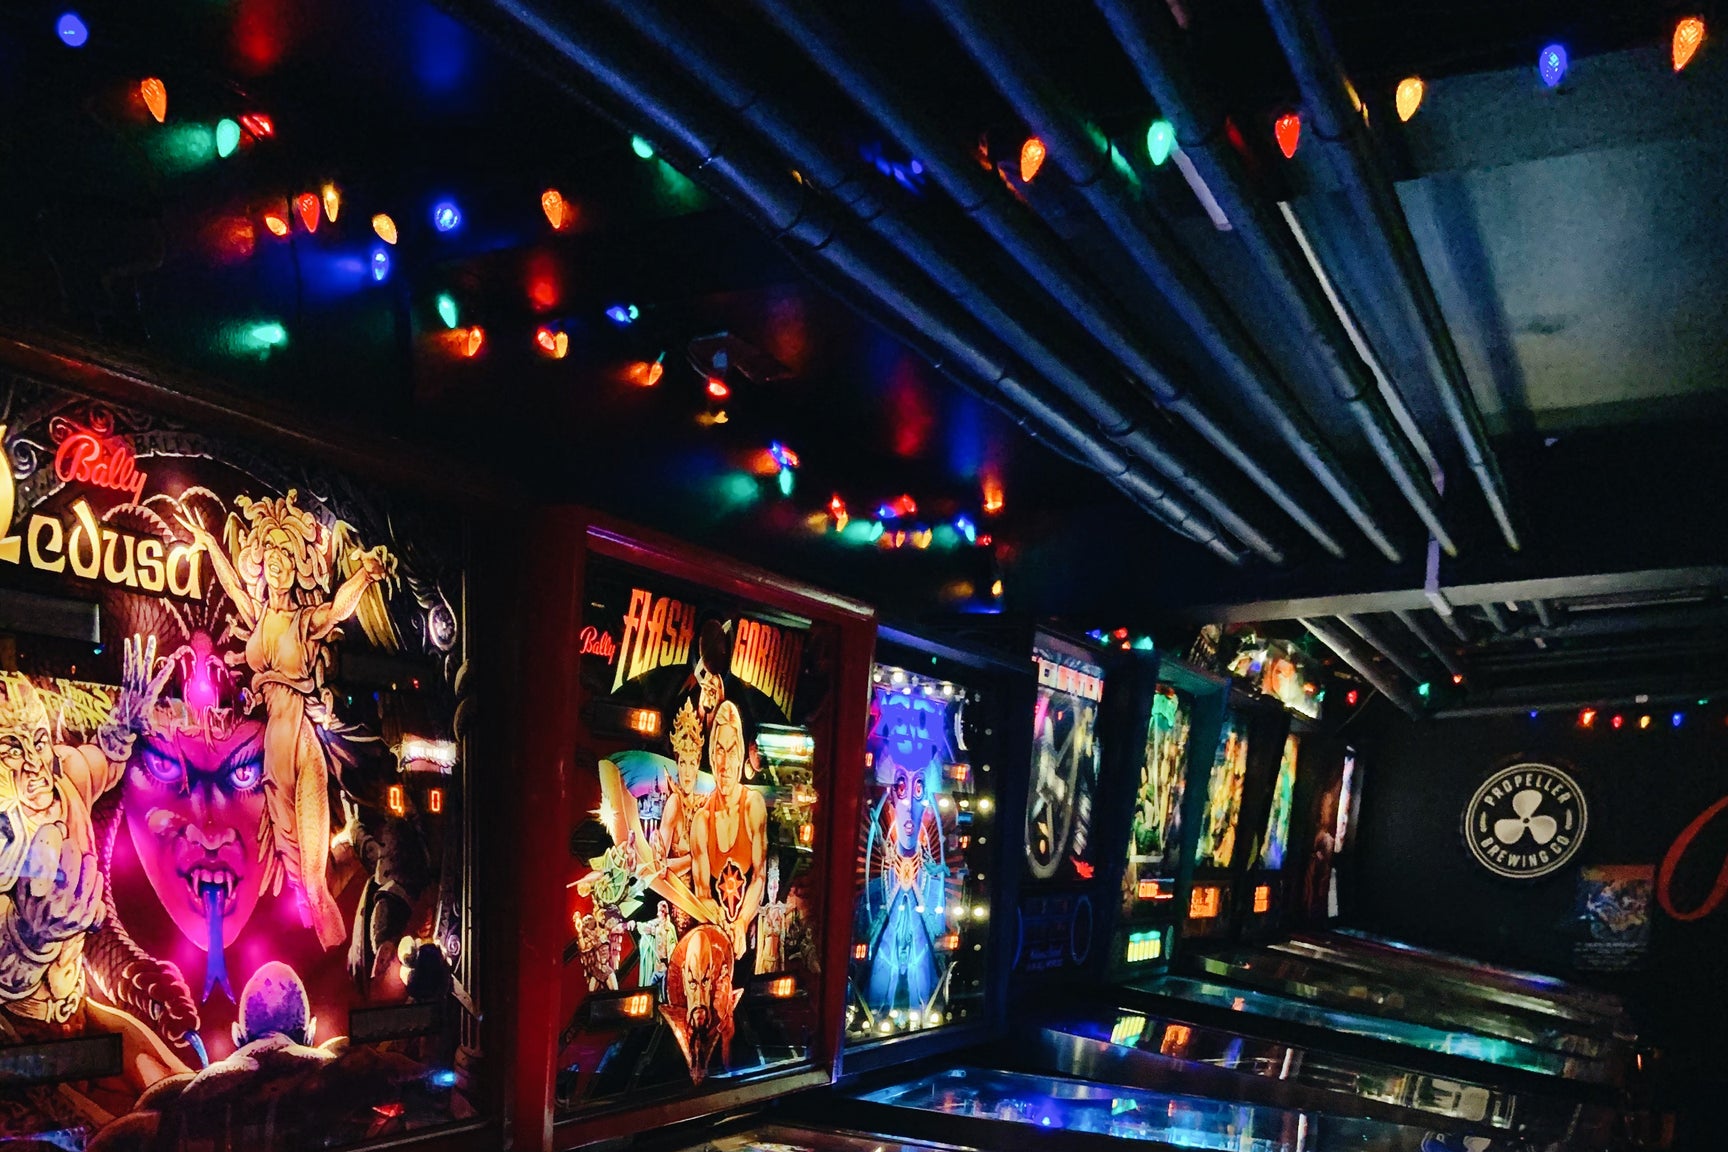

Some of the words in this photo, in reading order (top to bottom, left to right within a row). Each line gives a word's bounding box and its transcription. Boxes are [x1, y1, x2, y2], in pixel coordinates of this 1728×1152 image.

[55, 434, 148, 507] Bally
[0, 424, 202, 600] edusa
[580, 625, 616, 665] Bally
[611, 588, 697, 695] FLASH
[730, 618, 805, 723] GORDON
[1483, 774, 1572, 806] PROPELLER
[1480, 837, 1549, 867] BREWING
[1550, 835, 1571, 854] CO
